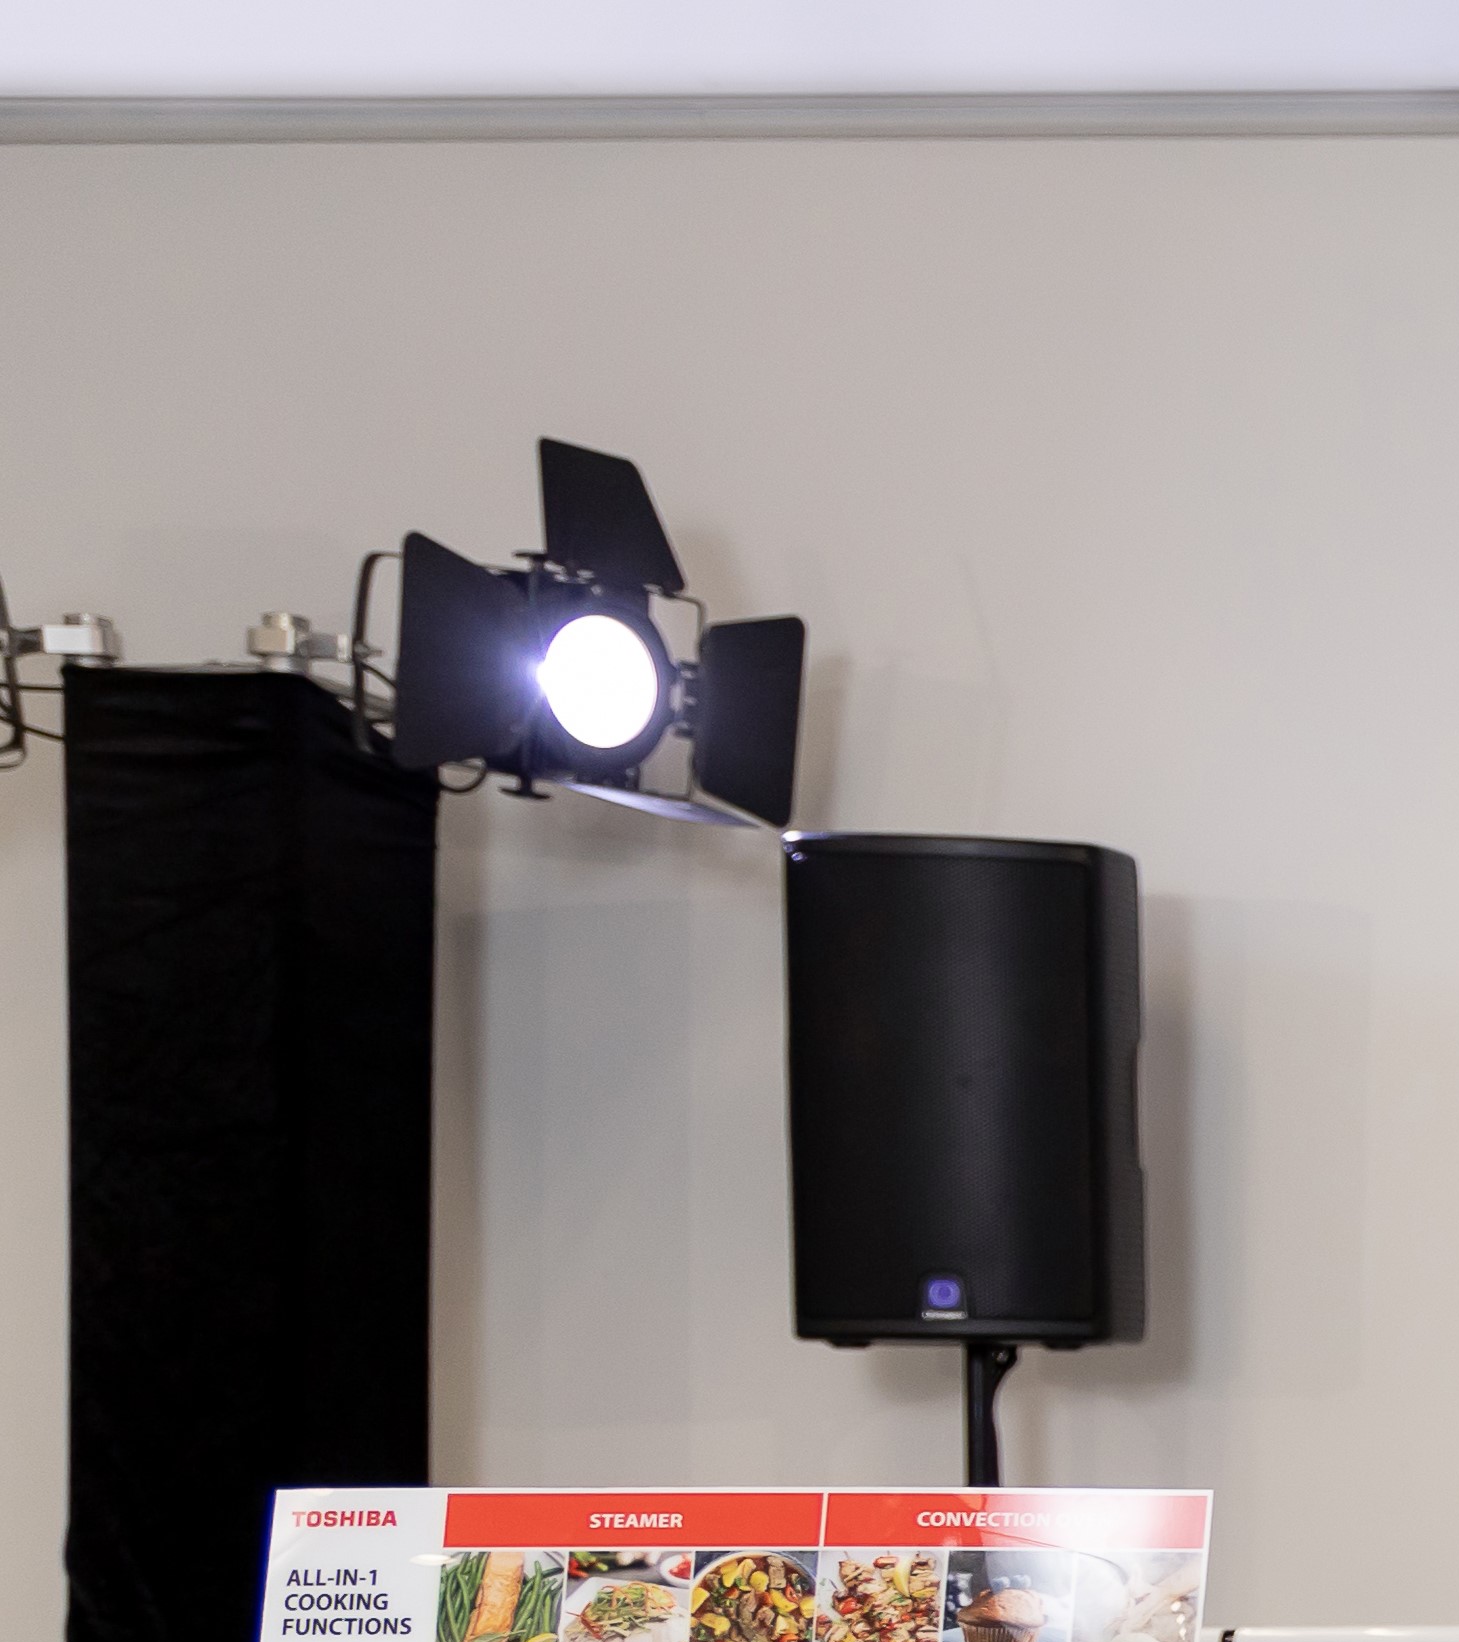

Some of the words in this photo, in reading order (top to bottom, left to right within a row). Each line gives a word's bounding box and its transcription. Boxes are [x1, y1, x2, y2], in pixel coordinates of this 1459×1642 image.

[292, 1510, 398, 1528] TOSHIBA
[589, 1513, 683, 1529] STEAMER
[917, 1511, 1049, 1528] CONVECTION
[287, 1569, 378, 1586] ALL-IN-1
[284, 1593, 389, 1611] COOKING
[282, 1617, 413, 1635] FUNCTIONS
